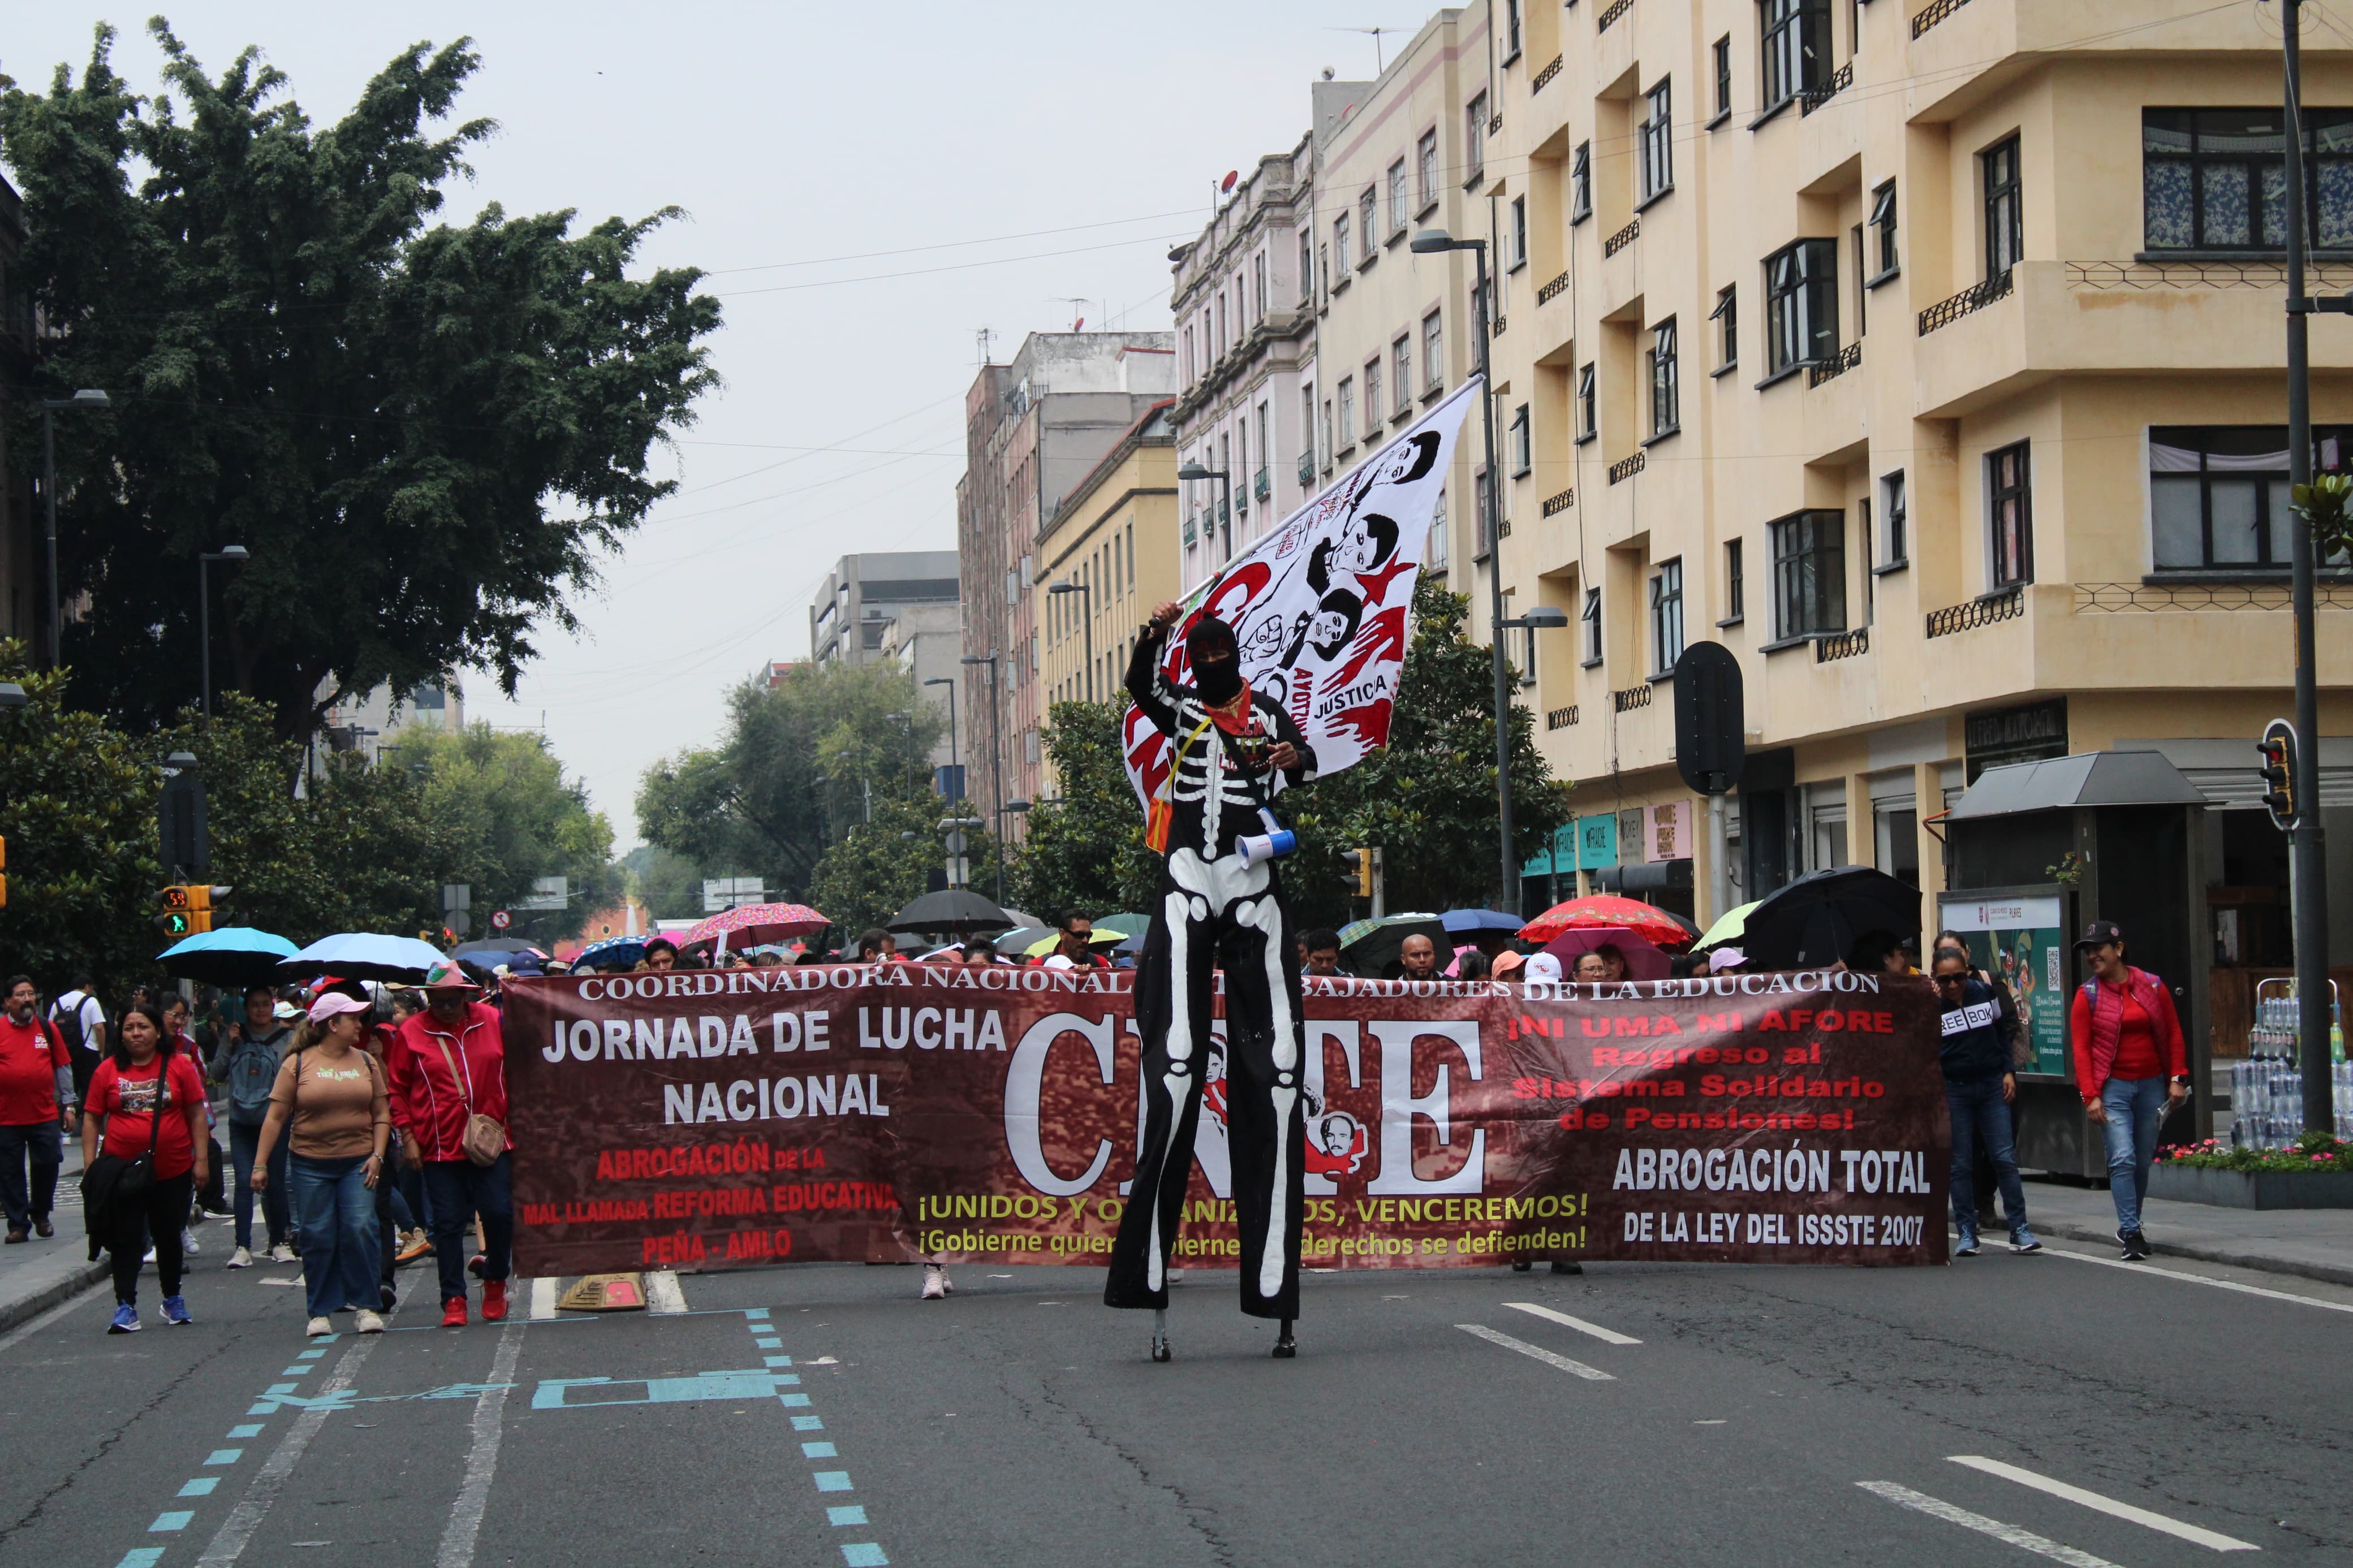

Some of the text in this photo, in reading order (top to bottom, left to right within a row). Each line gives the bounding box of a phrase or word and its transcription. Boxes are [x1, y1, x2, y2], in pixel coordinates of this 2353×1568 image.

[1291, 667, 1313, 741] AYOTZIN
[579, 965, 913, 1000] COORDINADORA
[922, 966, 1132, 994] NACIONAL
[1213, 973, 1512, 997] TBAJADORES
[1522, 982, 1579, 1002] DE
[1590, 982, 1642, 1000] LA
[542, 1007, 1007, 1064] JORNADA DE LUCHA
[1582, 1014, 1683, 1039] UMA
[1697, 1012, 1743, 1034] NI
[1757, 1009, 1894, 1035] AFORE
[1592, 1042, 1821, 1070] Regreso al
[664, 1074, 889, 1125] NACIONAL
[1512, 1074, 1885, 1099] Sistema Solidario
[1559, 1107, 1854, 1131] de Pensiones!
[596, 1136, 825, 1181] ABROGACIÓN DE LA
[1612, 1139, 1930, 1194] ABROGACIÓN TOTAL
[523, 1182, 902, 1225] MAL LLAMADA REFORMA EDUCATIVA
[920, 1195, 1058, 1221] ¡UNIDOS
[1072, 1198, 1088, 1220] Y
[1356, 1193, 1588, 1223] VENCEREMOS!
[643, 1229, 704, 1264] PEÑA
[726, 1229, 791, 1260] AMLO
[920, 1229, 1042, 1254] ¡Gobierne
[1300, 1232, 1413, 1255] derechos
[1421, 1237, 1449, 1255] se
[1456, 1226, 1586, 1255] defienden!
[1624, 1212, 1924, 1246] DE LA LEY DEL ISSSTE 2007
